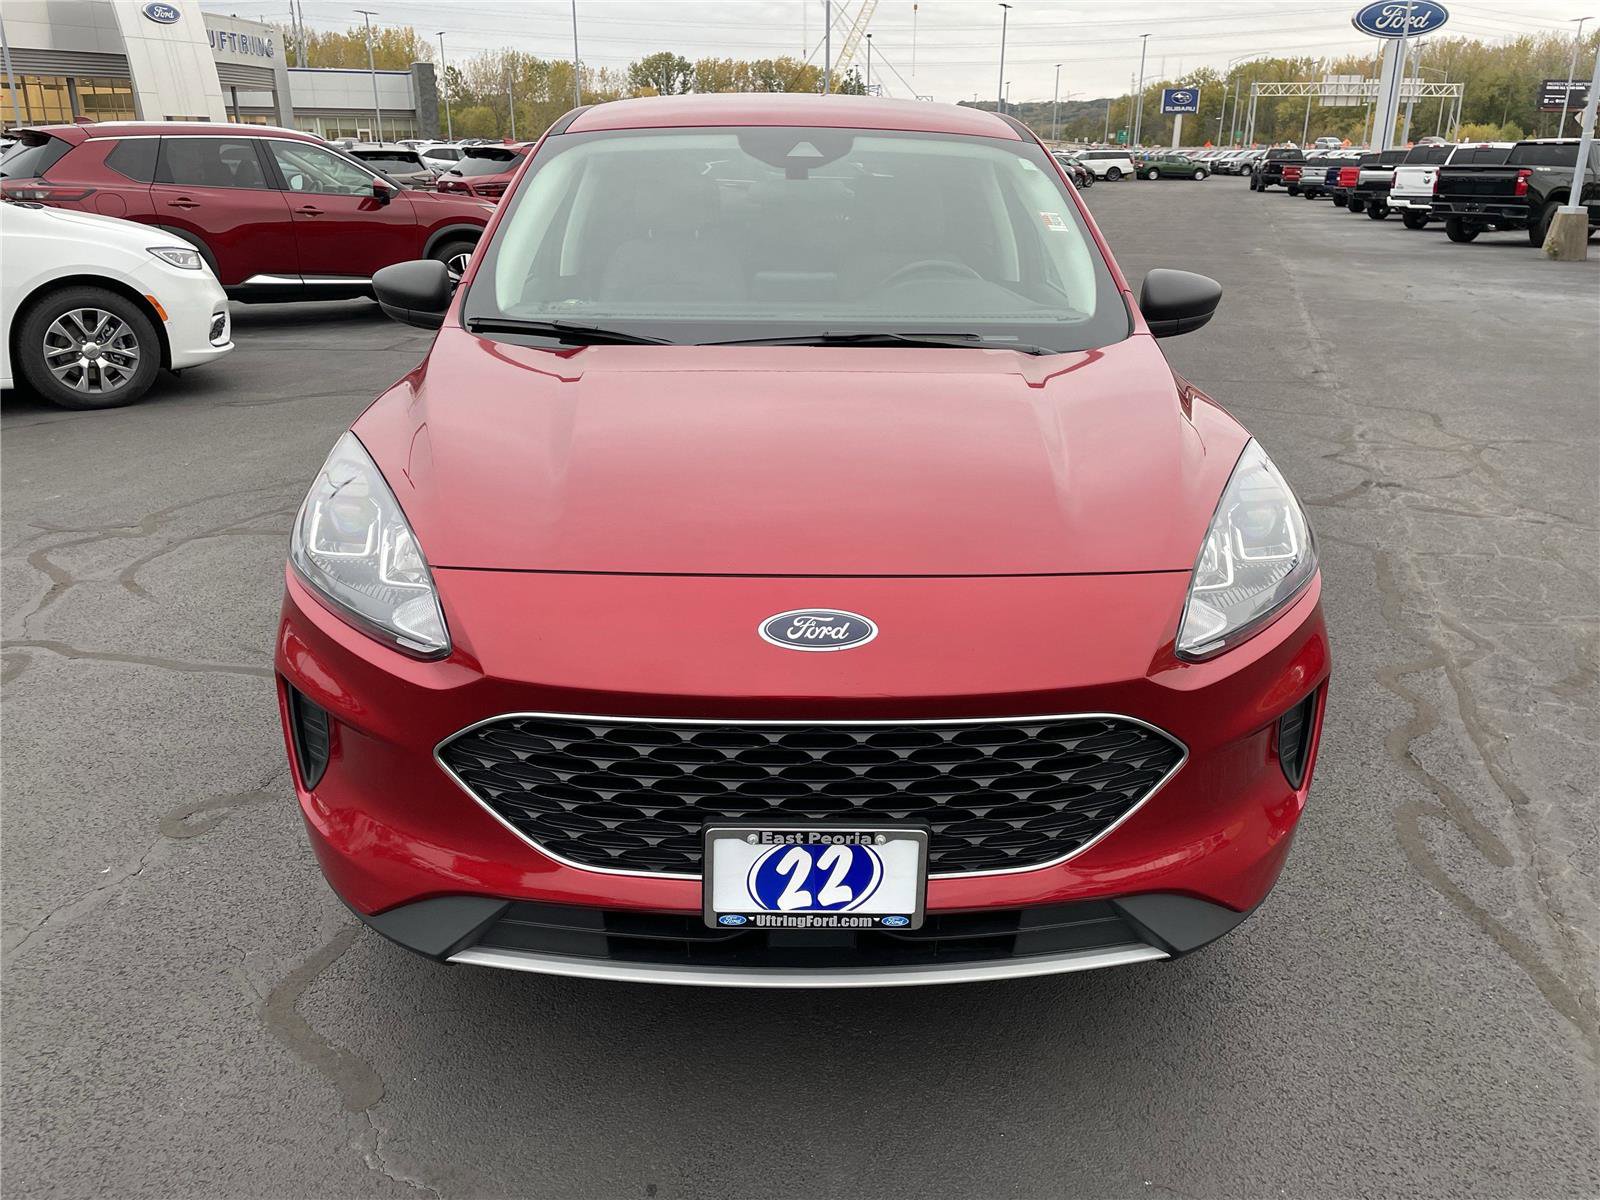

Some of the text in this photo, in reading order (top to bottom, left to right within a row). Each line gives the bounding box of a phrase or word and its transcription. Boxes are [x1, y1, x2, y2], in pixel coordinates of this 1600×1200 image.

[153, 6, 175, 19] Ford
[786, 615, 850, 640] Ford
[761, 831, 872, 846] East Peoria
[775, 843, 854, 912] 22
[755, 914, 873, 928] UftringFord.com
